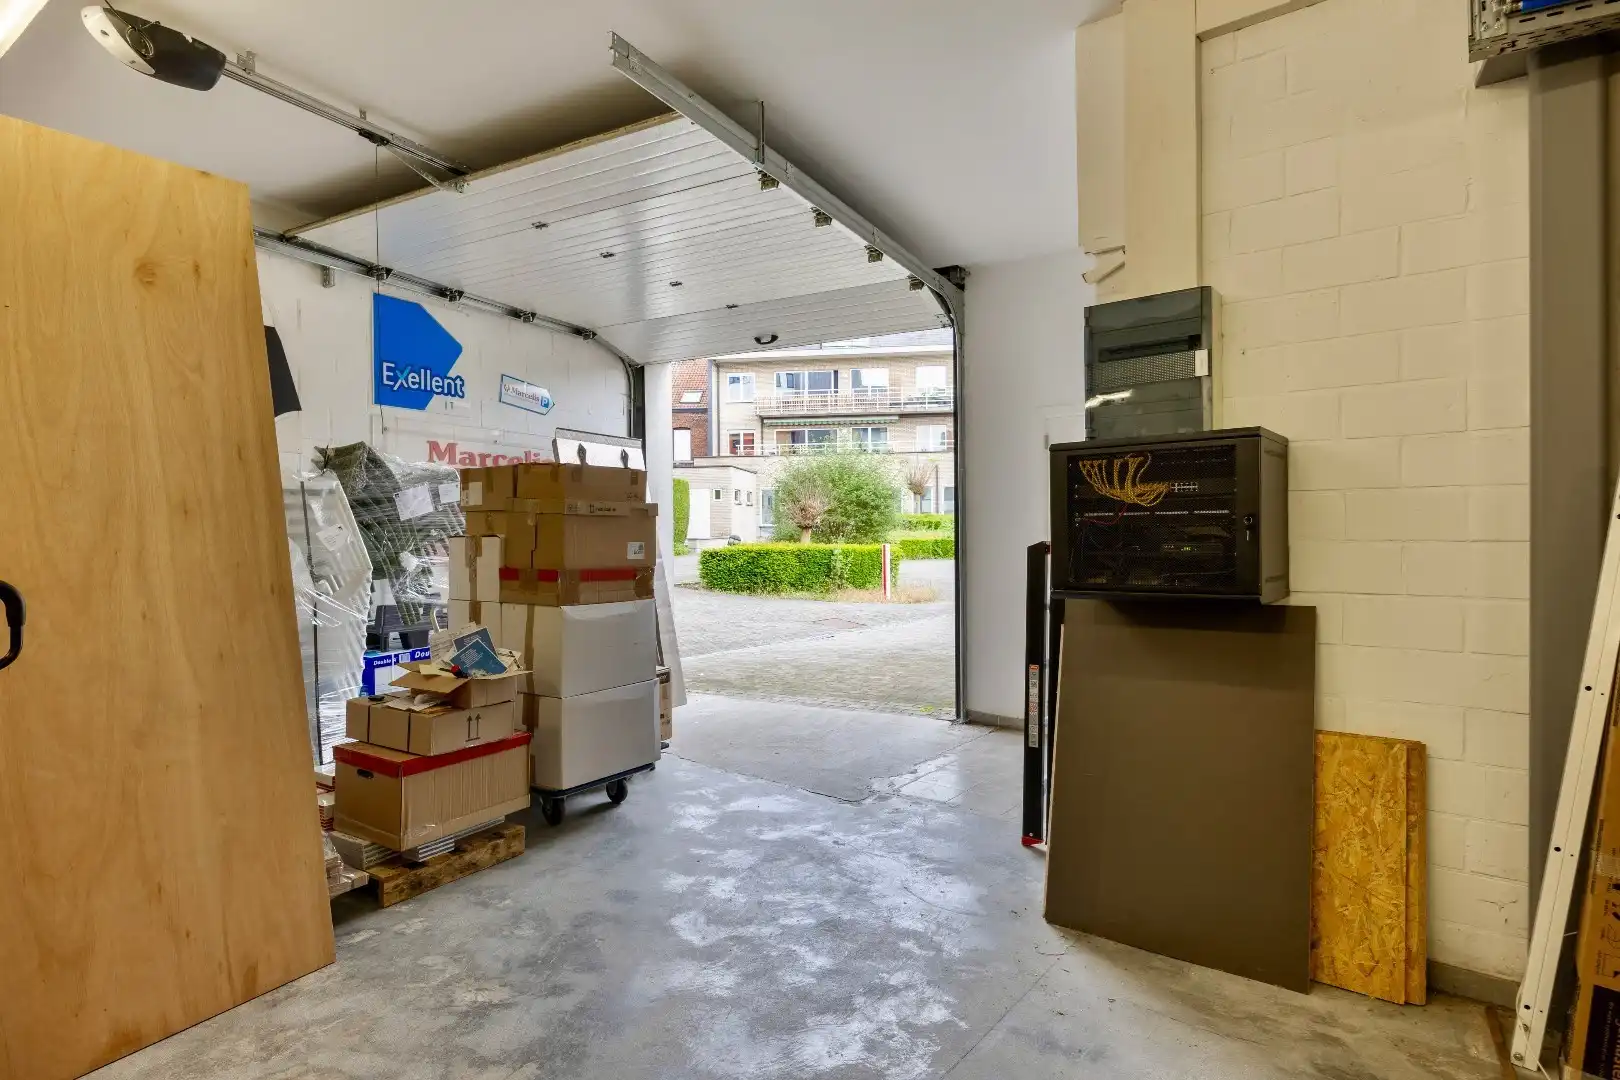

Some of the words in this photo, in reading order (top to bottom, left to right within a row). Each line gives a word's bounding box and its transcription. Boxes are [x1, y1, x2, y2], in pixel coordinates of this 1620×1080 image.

[382, 361, 463, 397] Exellent
[511, 385, 540, 402] Marcelis
[426, 440, 554, 467] Marceli
